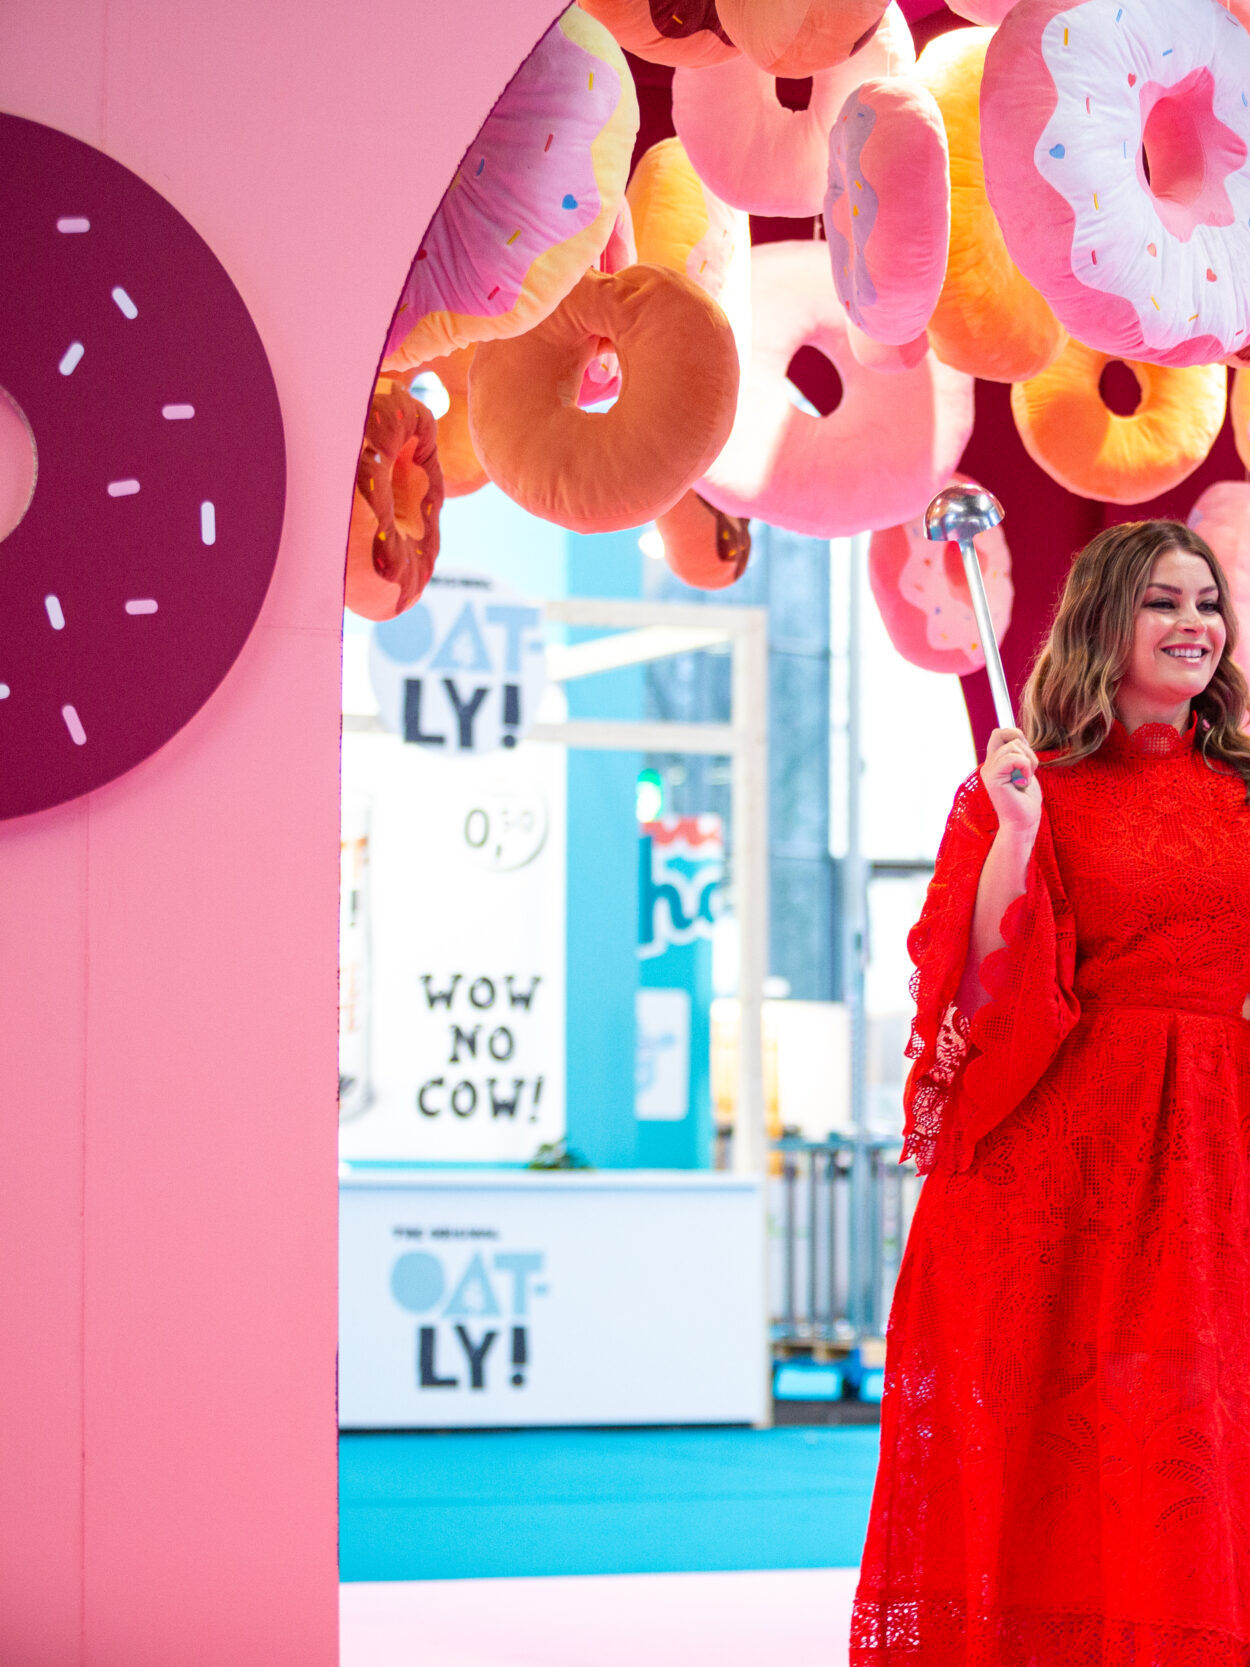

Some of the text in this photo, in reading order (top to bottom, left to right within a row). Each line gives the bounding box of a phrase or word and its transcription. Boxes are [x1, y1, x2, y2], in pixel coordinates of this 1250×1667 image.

[403, 678, 521, 750] LY!
[420, 972, 543, 1011] WOW
[448, 1023, 515, 1063] NO
[417, 1075, 546, 1125] COW!
[419, 1323, 528, 1389] LY!
